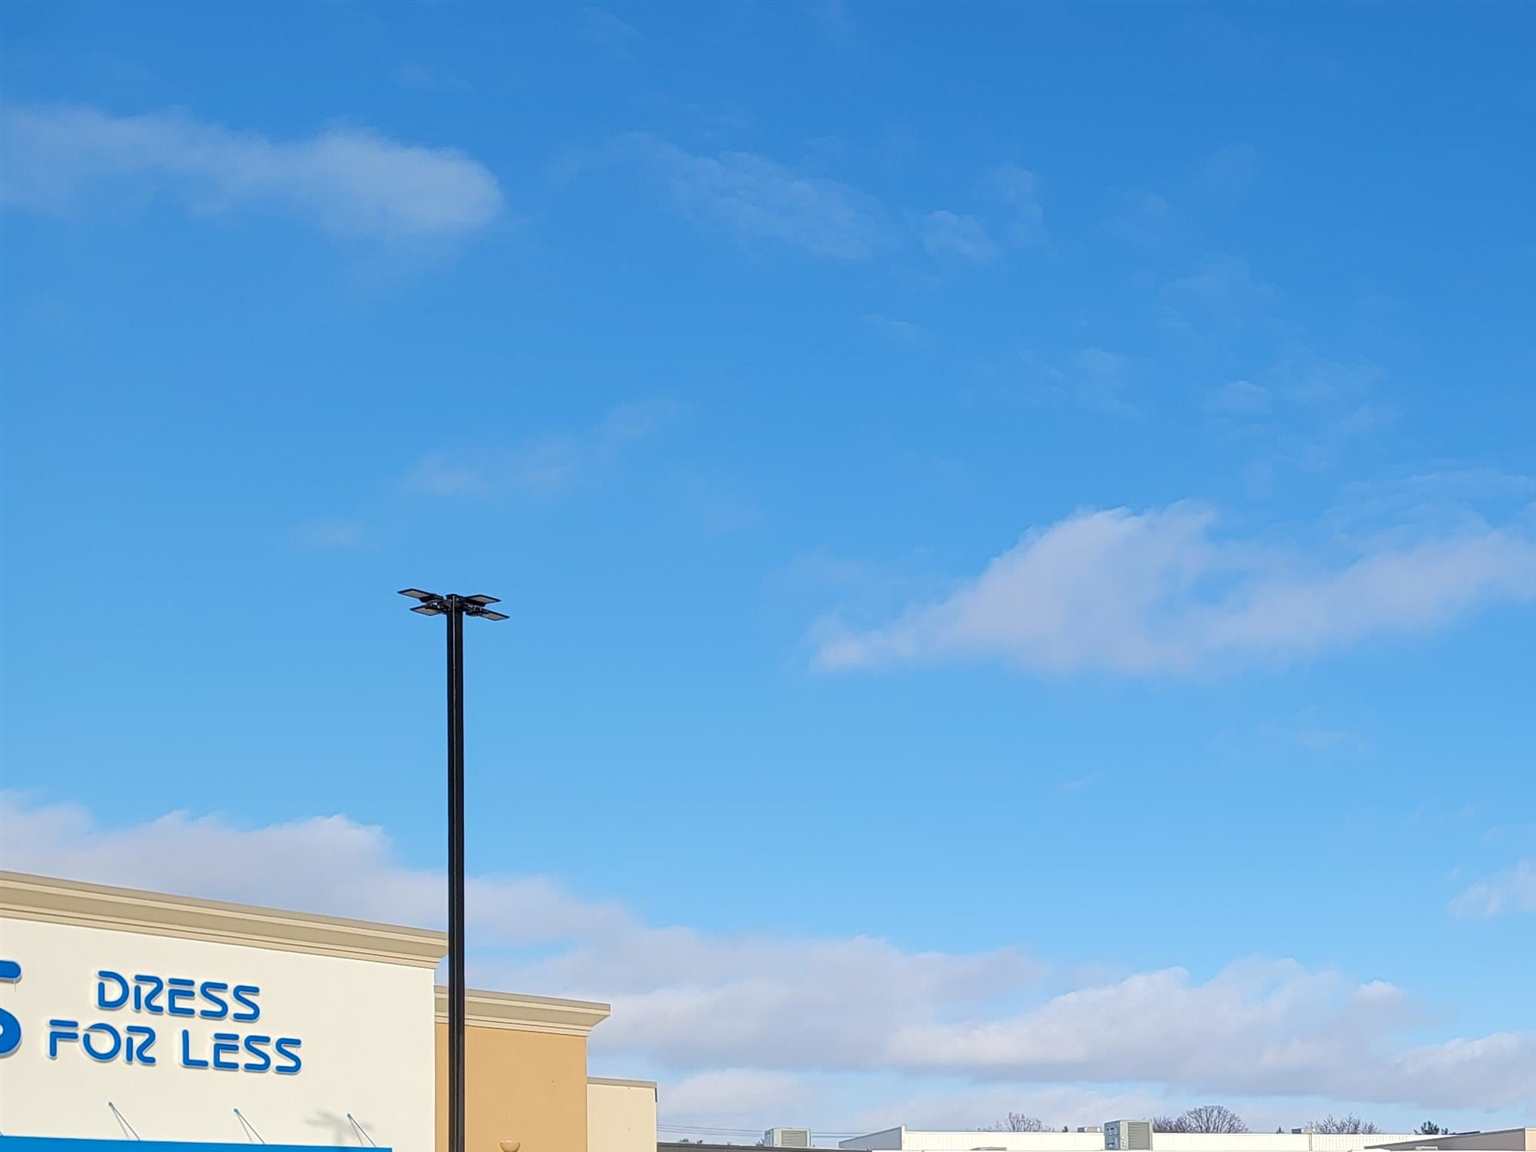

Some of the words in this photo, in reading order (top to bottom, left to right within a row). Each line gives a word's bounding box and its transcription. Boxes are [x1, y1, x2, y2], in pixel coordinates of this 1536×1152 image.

[97, 970, 261, 1023] DRESS
[49, 1018, 157, 1065] FOR
[181, 1028, 303, 1075] LESS
